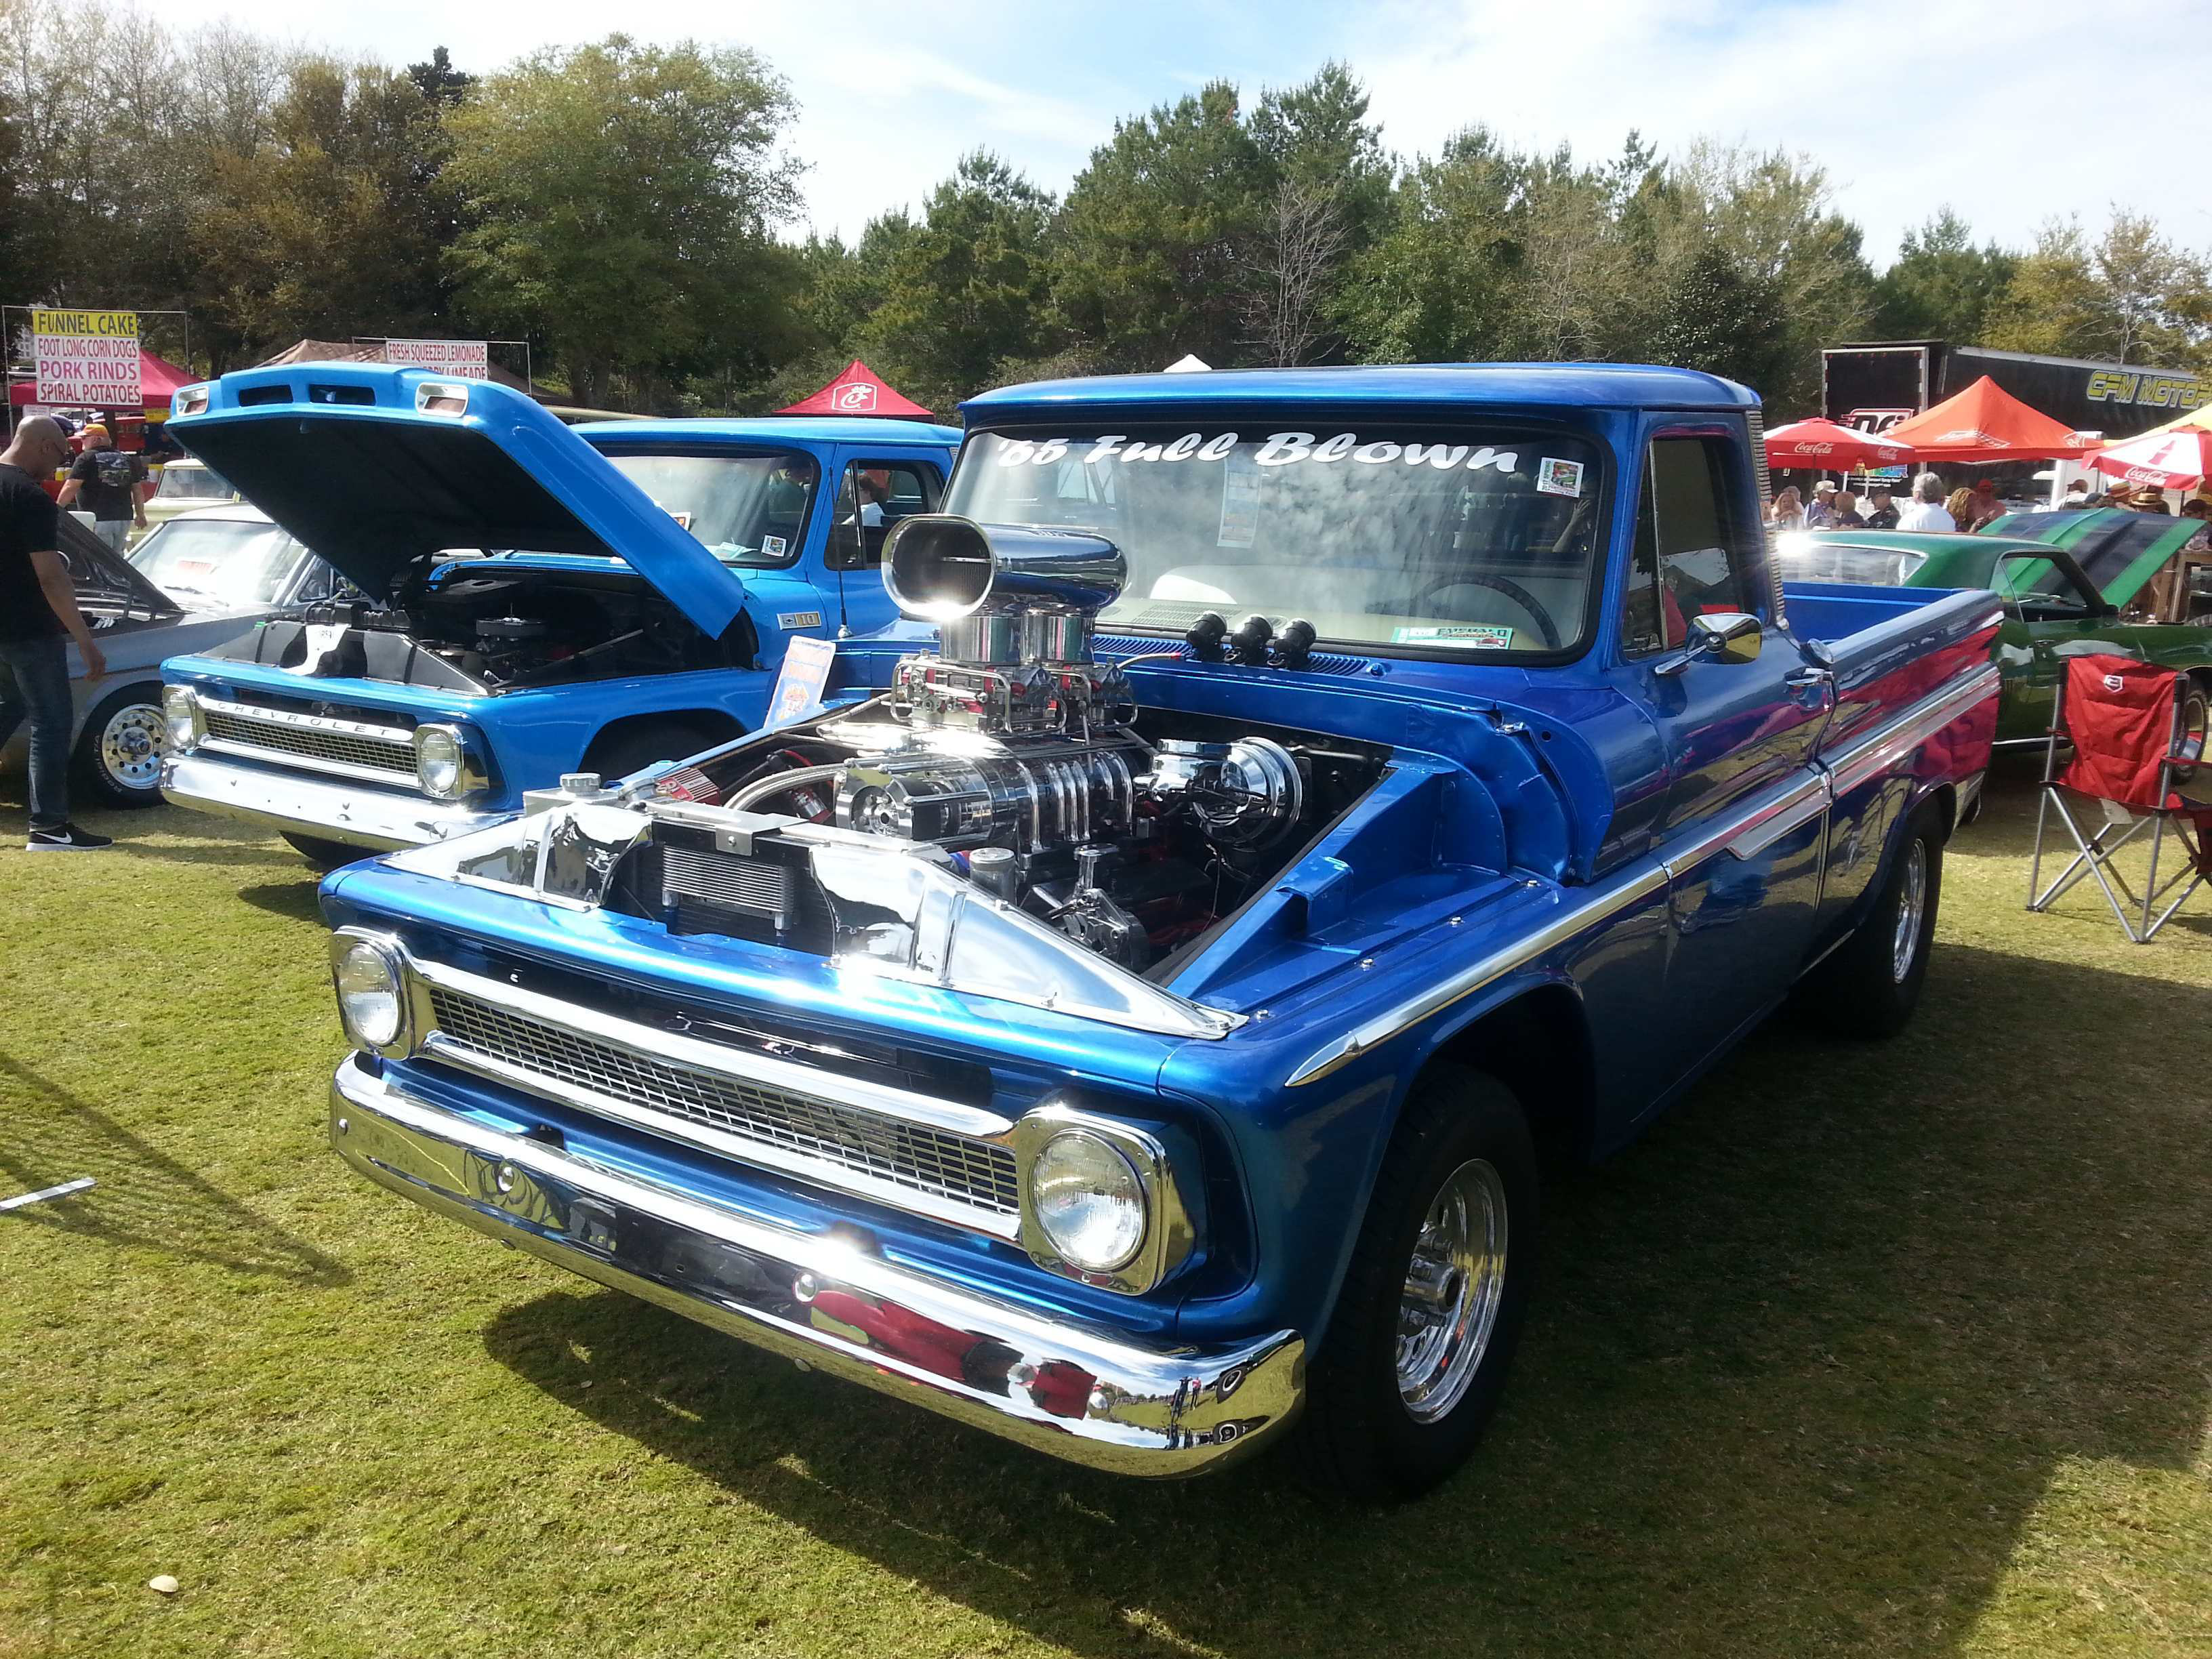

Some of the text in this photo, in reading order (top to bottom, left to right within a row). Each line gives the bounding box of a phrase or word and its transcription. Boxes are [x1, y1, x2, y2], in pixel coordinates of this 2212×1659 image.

[38, 313, 135, 335] FUNNEL CAKE
[38, 338, 137, 358] FOOT LONG CORN DOGS
[389, 343, 485, 362] FRESH SQUEEZED LEMONADE
[40, 361, 137, 380] PORK RINDS
[41, 383, 141, 403] SPIRAL POTATOES
[1084, 432, 1238, 464] Full
[1255, 432, 1518, 472] Blown
[801, 614, 814, 624] 10
[218, 702, 390, 736] CHEVROLET
